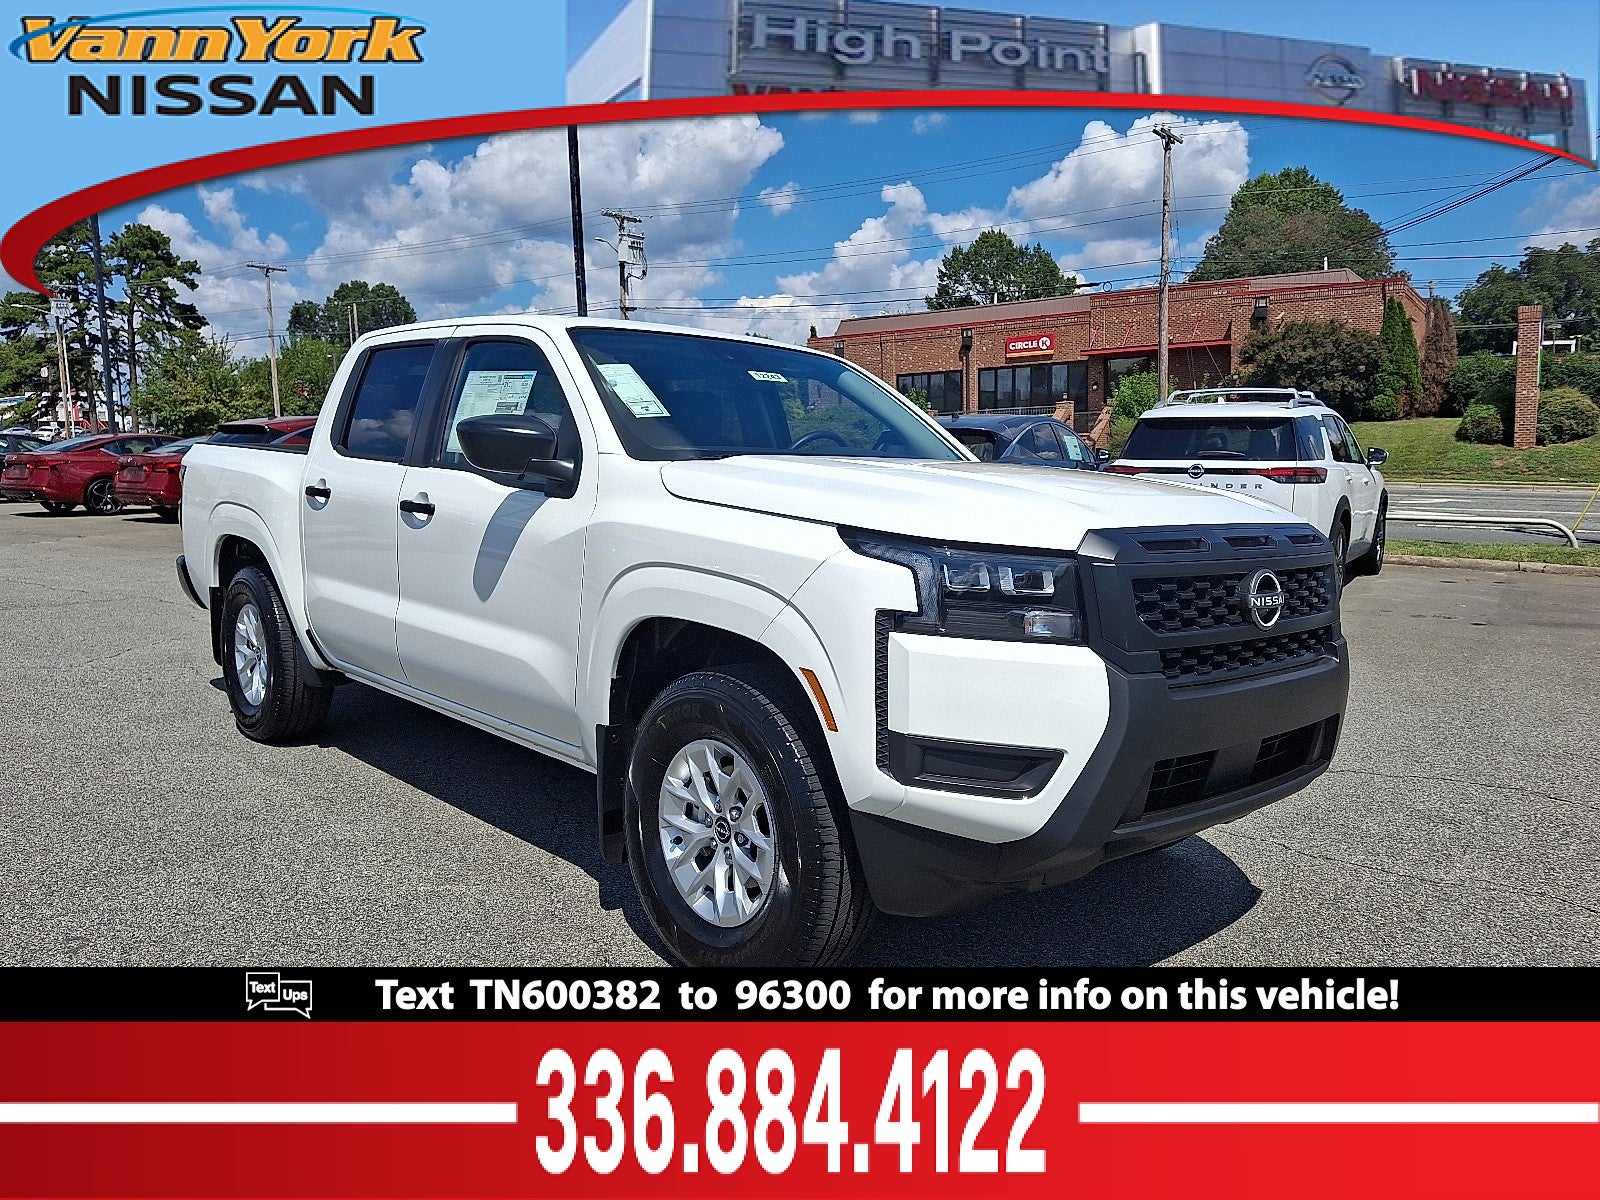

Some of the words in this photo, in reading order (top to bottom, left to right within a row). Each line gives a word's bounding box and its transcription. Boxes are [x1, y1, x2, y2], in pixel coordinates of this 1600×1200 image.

[750, 13, 922, 65] High
[949, 29, 1110, 73] Point
[1009, 340, 1038, 351] CIRCLE
[1040, 337, 1051, 350] K
